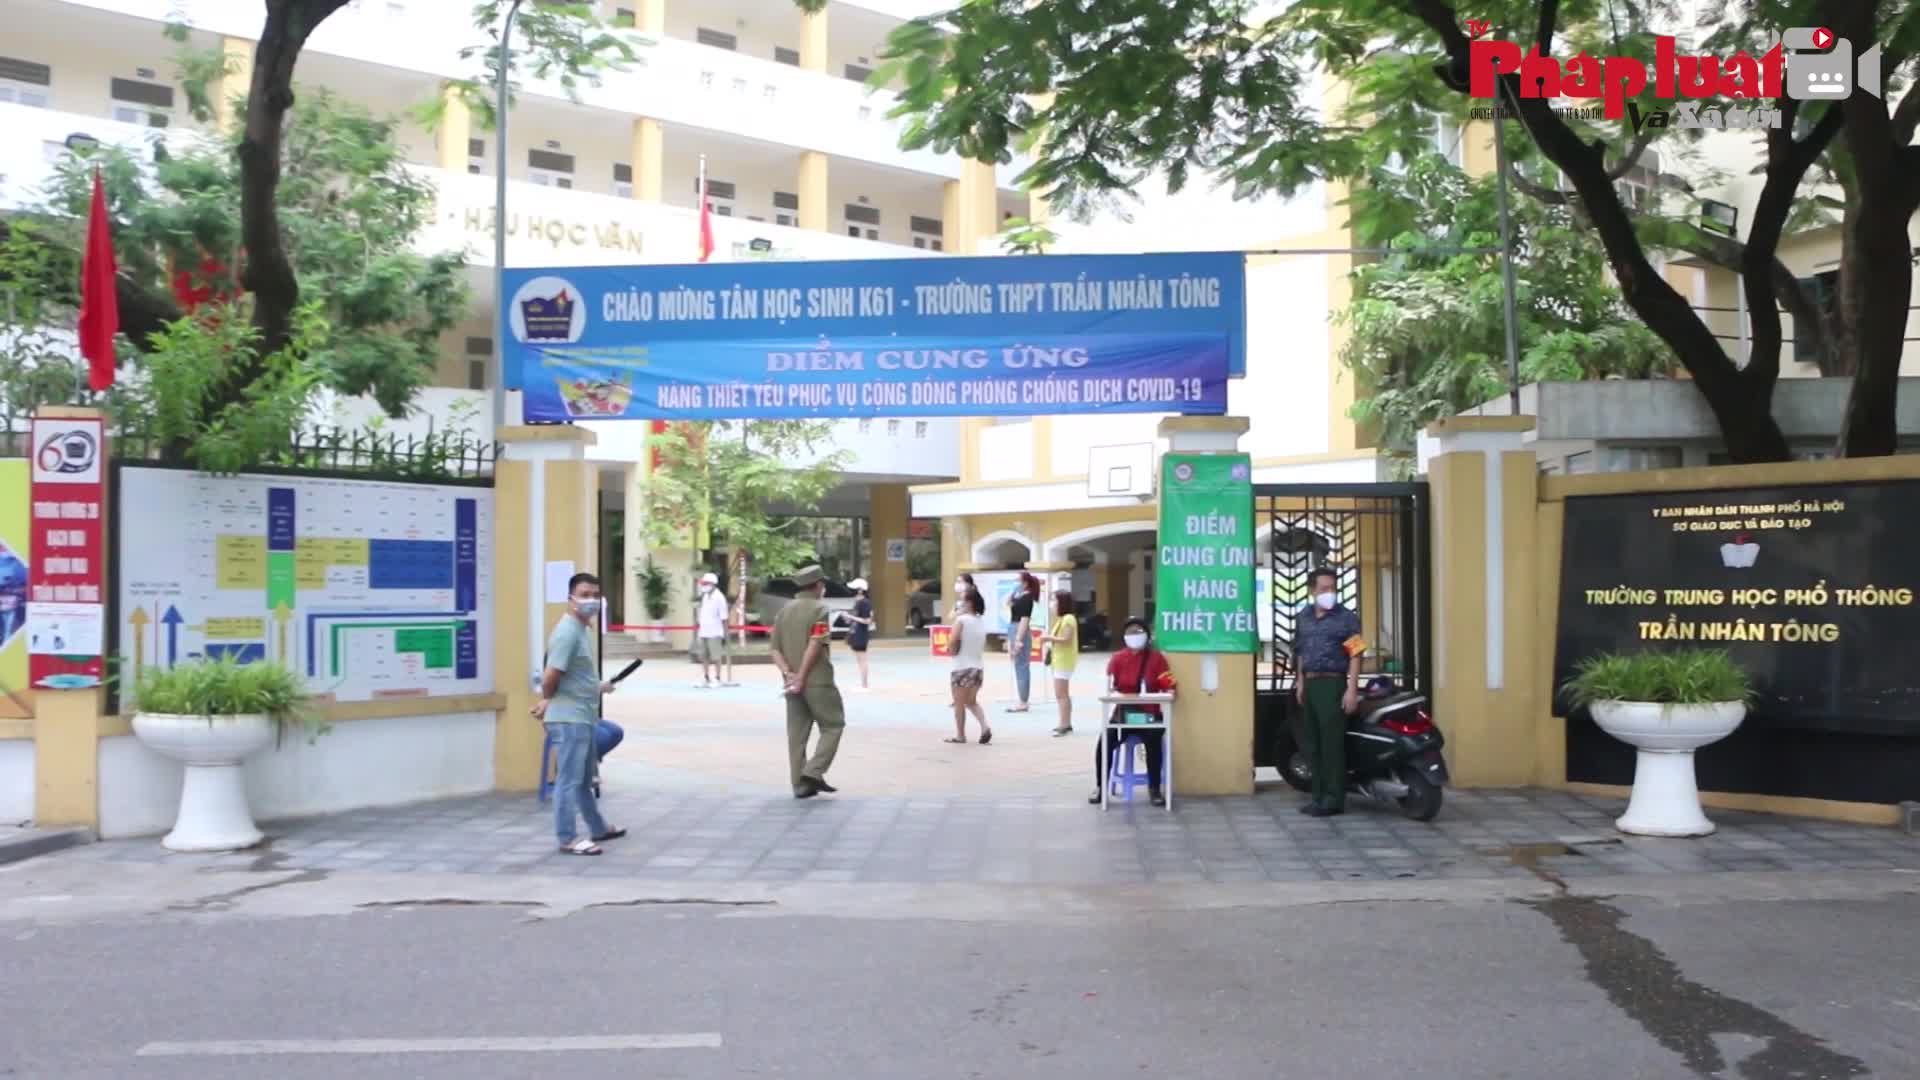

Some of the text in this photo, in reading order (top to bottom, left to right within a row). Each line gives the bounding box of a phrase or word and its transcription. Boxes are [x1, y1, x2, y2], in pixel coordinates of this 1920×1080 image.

[528, 215, 588, 249] HỌC
[594, 221, 643, 255] VĂN
[602, 285, 653, 321] CHÀO
[658, 283, 716, 321] MỪNG
[719, 282, 758, 320] TÂN
[763, 287, 802, 325] HỌC
[807, 286, 854, 318] SINH
[860, 286, 894, 317] K61
[914, 276, 993, 315] TRƯỜNG
[997, 282, 1046, 313] THPT
[1107, 273, 1163, 310] NHÂN
[1167, 271, 1220, 308] TÔNG
[876, 349, 989, 370] CUNG
[1001, 342, 1089, 369] ỨNG
[657, 380, 702, 409] HÀNG
[706, 377, 751, 409] THIẾT
[753, 377, 784, 408] YẾU
[788, 383, 832, 413] PHỤC
[836, 383, 857, 412] VỤ
[862, 377, 907, 412] CỘNG
[961, 375, 1018, 405] PHÒNG
[1022, 371, 1079, 404] CHỐNG
[1084, 378, 1122, 408] DỊCH
[1127, 377, 1203, 402] COVID-19
[1803, 499, 1821, 513] HÀ
[1823, 499, 1845, 514] NỘI
[1185, 507, 1236, 537] ĐIỂM
[1788, 518, 1812, 530] TẠO
[1161, 545, 1216, 567] CUNG
[1183, 576, 1239, 600] HÀNG
[1584, 579, 1913, 609] TRƯỜNG TRUNG HỌC PHỔ THÔNG
[1162, 604, 1217, 632] THIẾT
[1638, 612, 1840, 642] TRẦN NHÂN TÔNG
